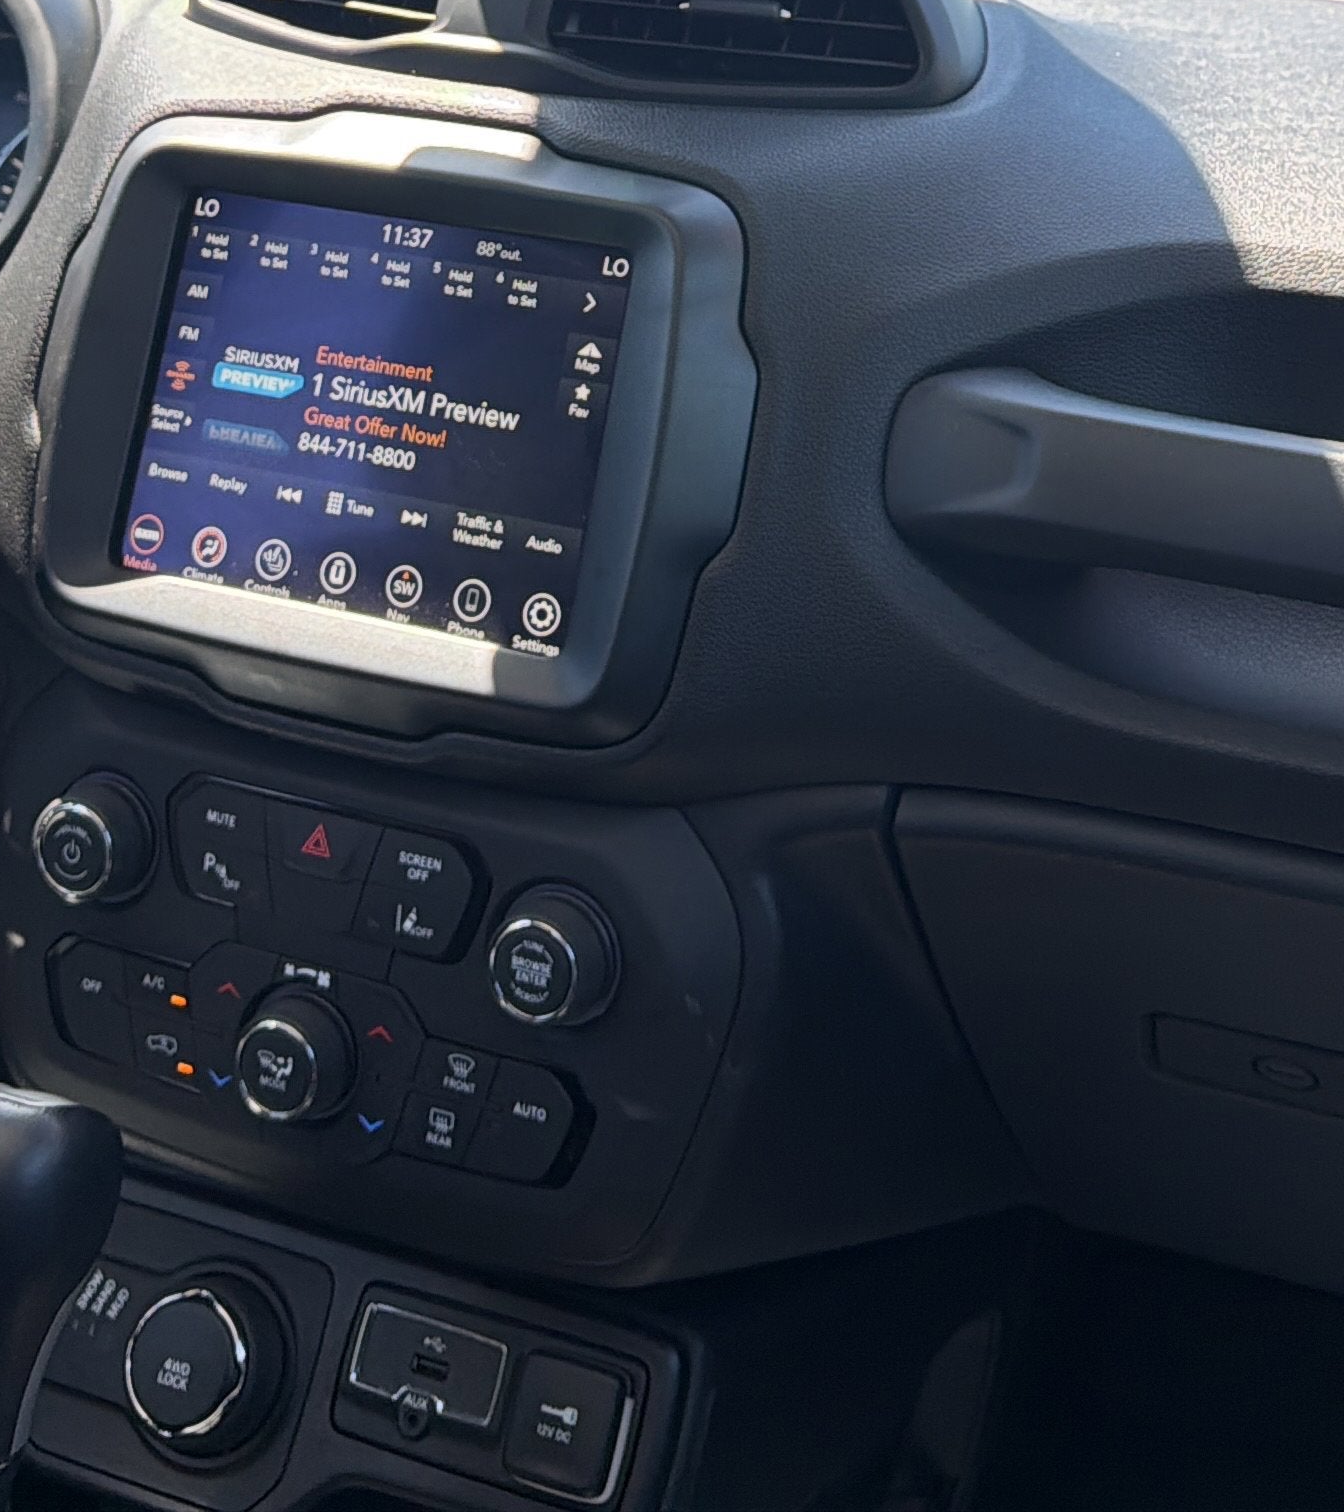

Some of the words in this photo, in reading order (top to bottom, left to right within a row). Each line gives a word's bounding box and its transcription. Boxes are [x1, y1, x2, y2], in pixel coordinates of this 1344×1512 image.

[194, 196, 221, 218] LO
[192, 226, 199, 237] 1
[205, 233, 230, 247] Hold
[249, 234, 259, 247] 2
[382, 223, 434, 249] 11:37
[265, 241, 289, 256] Hold
[309, 243, 319, 255] 3
[324, 250, 350, 265] Hold
[370, 252, 380, 264] 4
[386, 259, 411, 274] Hold
[433, 262, 442, 274] 5
[448, 269, 473, 283] Hold
[602, 256, 630, 278] LO
[496, 271, 505, 284] 6
[512, 278, 538, 294] Hold
[187, 284, 209, 299] AM
[178, 325, 199, 342] FM
[224, 346, 300, 373] SIRIUSXM
[315, 345, 434, 383] Entertainment
[574, 358, 600, 375] Map
[220, 368, 295, 392] PREVIEW
[152, 403, 184, 420] Source
[312, 373, 323, 397] 1
[329, 375, 426, 414] SiriusXM
[429, 393, 520, 431] Preview
[568, 403, 589, 419] Fav
[151, 417, 180, 433] Select
[304, 406, 351, 431] Great
[355, 415, 397, 439] Offer
[401, 423, 448, 448] Now!
[297, 432, 416, 471] 844-711-8800
[148, 462, 188, 482] Browse
[209, 473, 247, 495] Replay
[346, 499, 374, 517] Tune
[457, 511, 492, 532] Traffic
[494, 519, 504, 534] &
[453, 528, 503, 551] Weather
[525, 535, 563, 555] Audio
[123, 554, 158, 571] Media
[182, 566, 224, 585] Climate
[244, 579, 291, 598] Controls
[393, 580, 416, 597] SW
[386, 608, 411, 624] Nav
[447, 620, 485, 639] Phone
[512, 634, 560, 657] Settings
[206, 809, 237, 829] MUTE
[399, 850, 442, 872] SCREEN
[407, 868, 429, 882] OFF
[511, 955, 552, 973] BROWSE
[80, 977, 102, 993] OFF
[142, 972, 165, 991] A/C
[515, 968, 547, 988] ENTER
[258, 1073, 287, 1092] MODE
[443, 1075, 476, 1094] FRONT
[512, 1101, 547, 1122] AUTO
[425, 1131, 453, 1148] REAR
[163, 1357, 191, 1376] 4WD
[156, 1370, 188, 1393] LOCK
[403, 1392, 428, 1411] AUX
